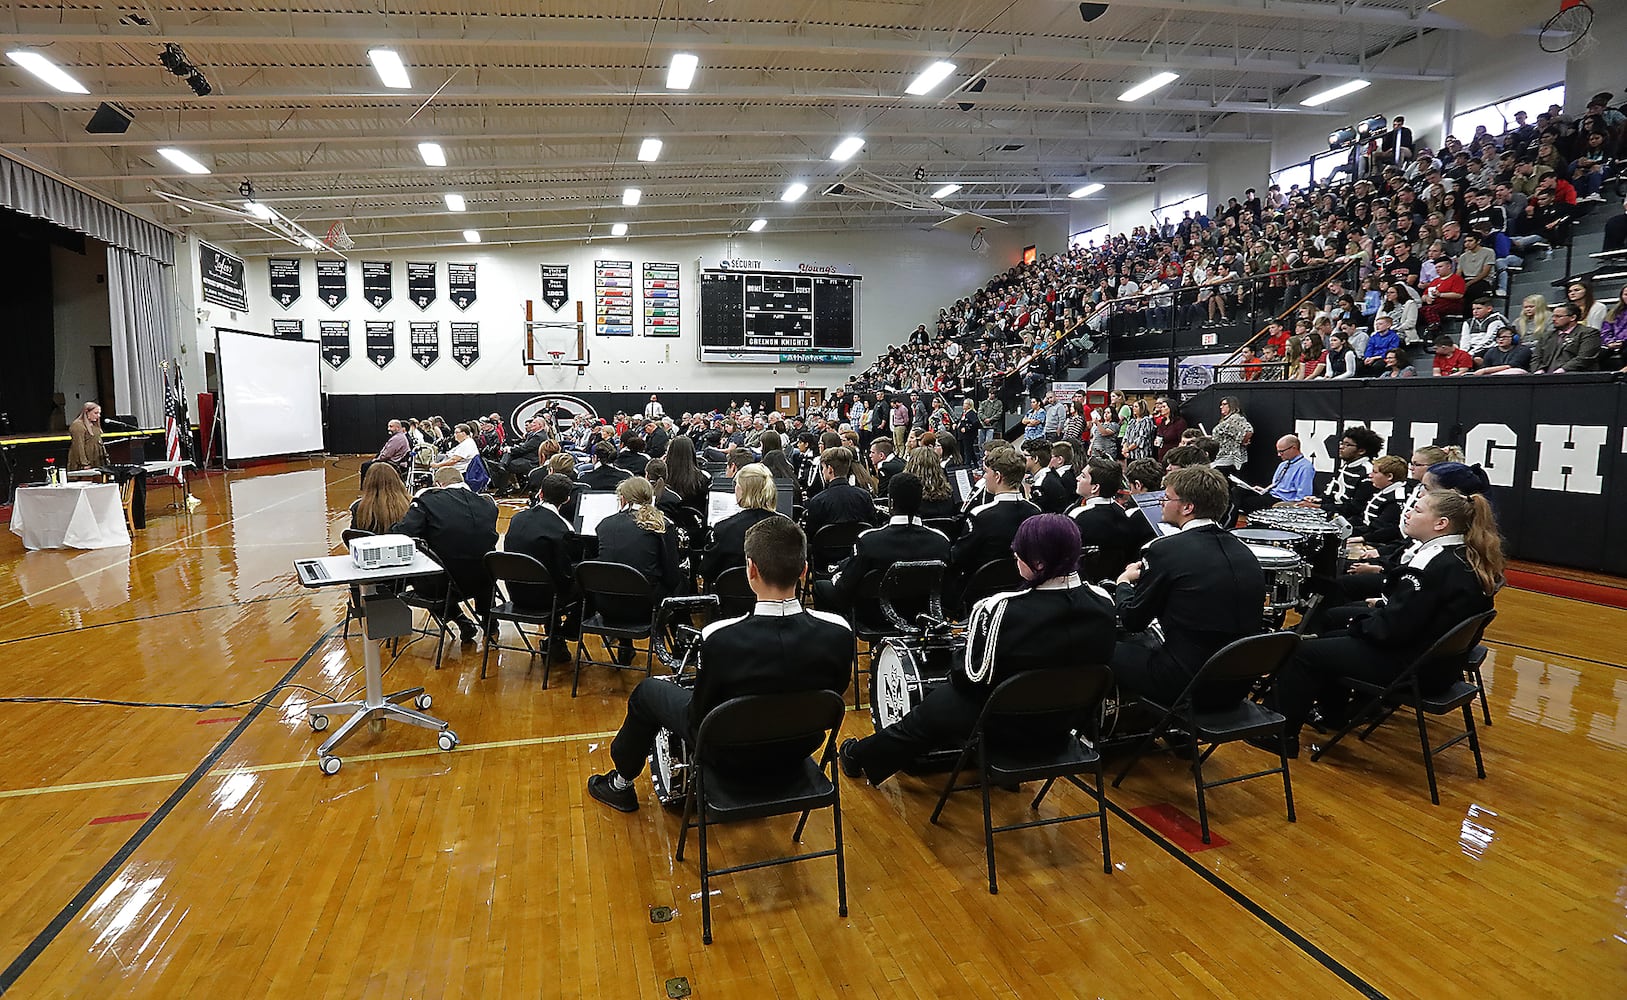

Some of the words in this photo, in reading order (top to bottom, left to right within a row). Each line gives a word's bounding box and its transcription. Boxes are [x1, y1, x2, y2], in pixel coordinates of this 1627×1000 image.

[731, 260, 761, 269] SECURITY
[786, 354, 825, 362] Athletes
[1142, 377, 1168, 385] GREENO
[1295, 420, 1627, 494] KIGH
